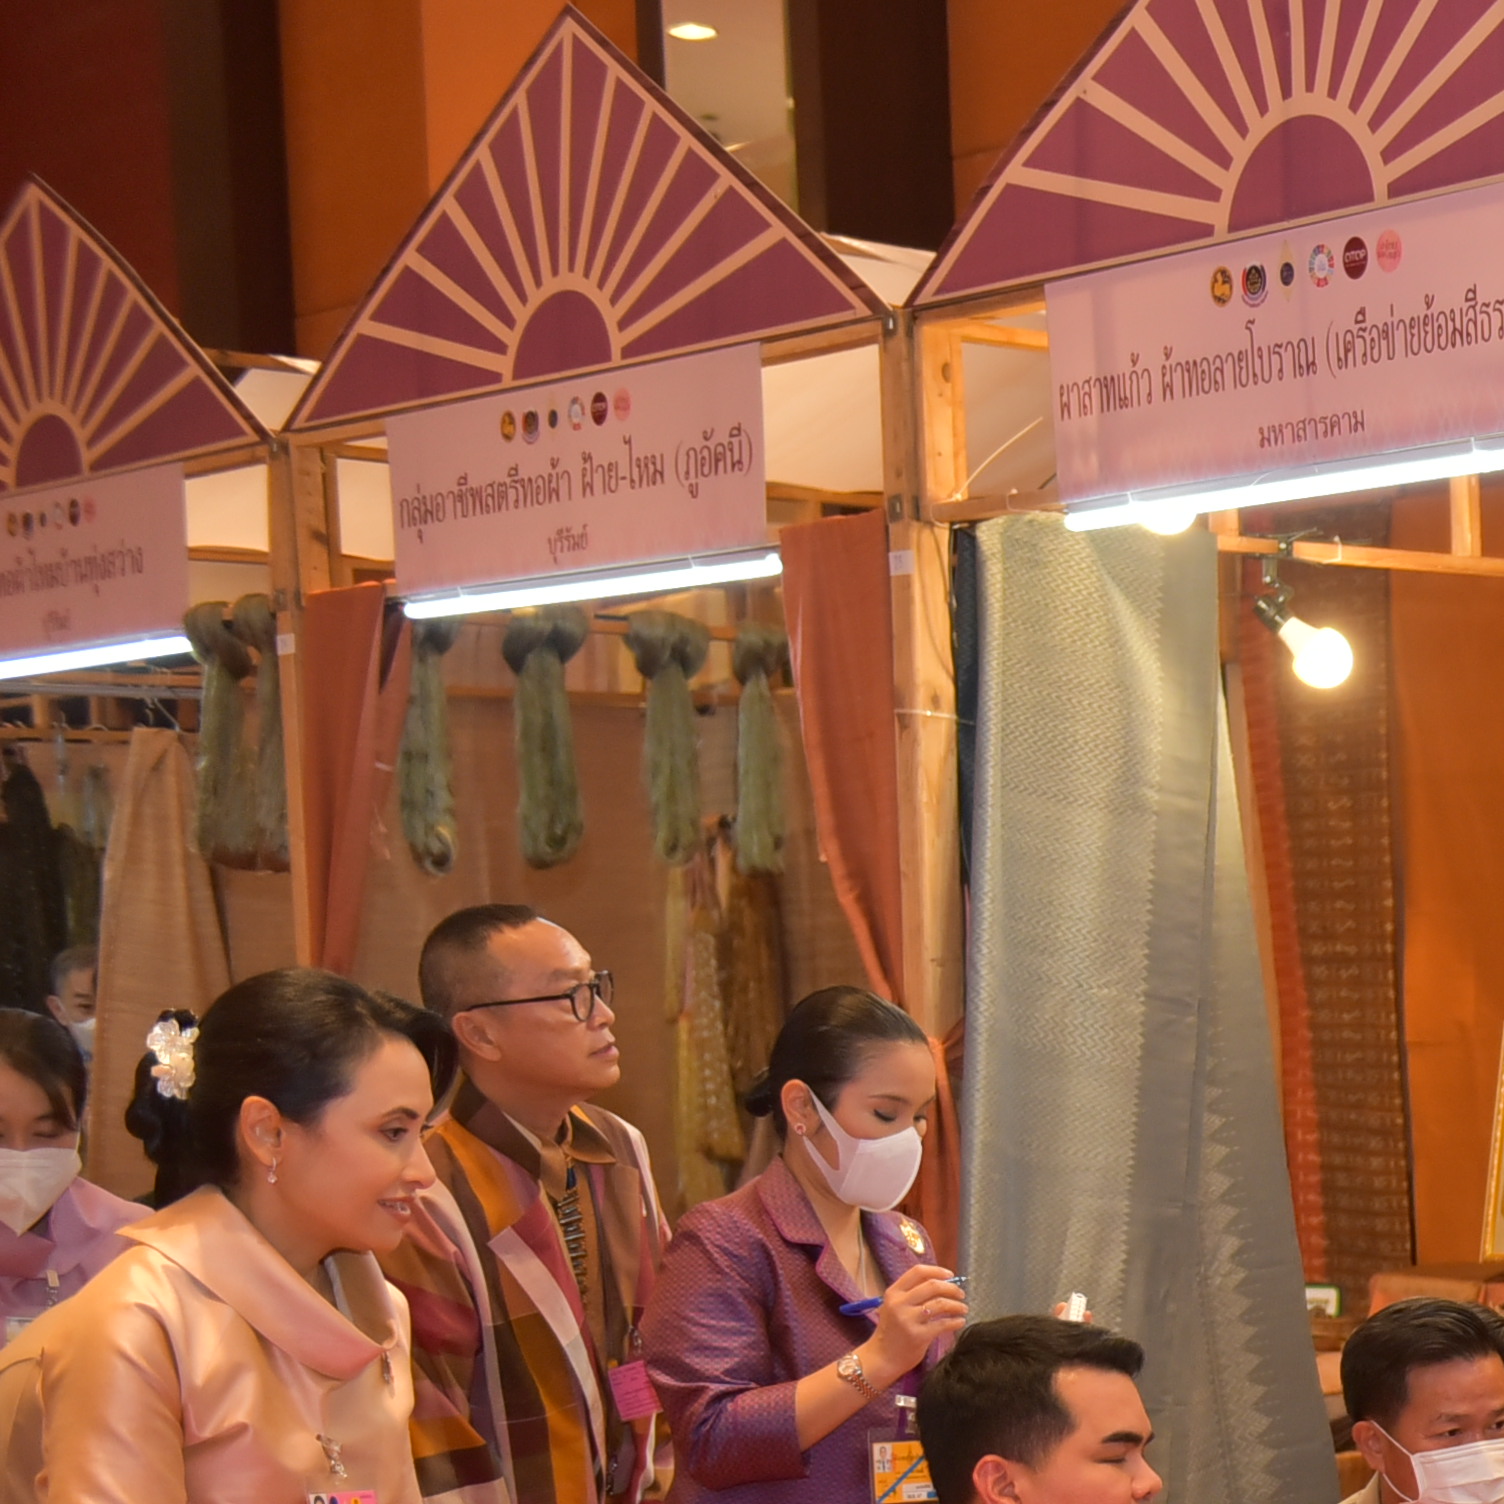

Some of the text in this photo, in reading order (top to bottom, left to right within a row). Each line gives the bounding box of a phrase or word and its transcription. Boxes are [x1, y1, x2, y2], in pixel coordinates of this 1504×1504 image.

[1059, 352, 1153, 421] ผาสาทแก้ว
[1161, 318, 1318, 402] ผ้าทอลายโบราณ
[1258, 409, 1365, 449] มหาสารคาม
[400, 456, 572, 544] กลุ่มอาชีพสตรีทอผ้า
[581, 434, 665, 498] ฝ้าย-ไหม
